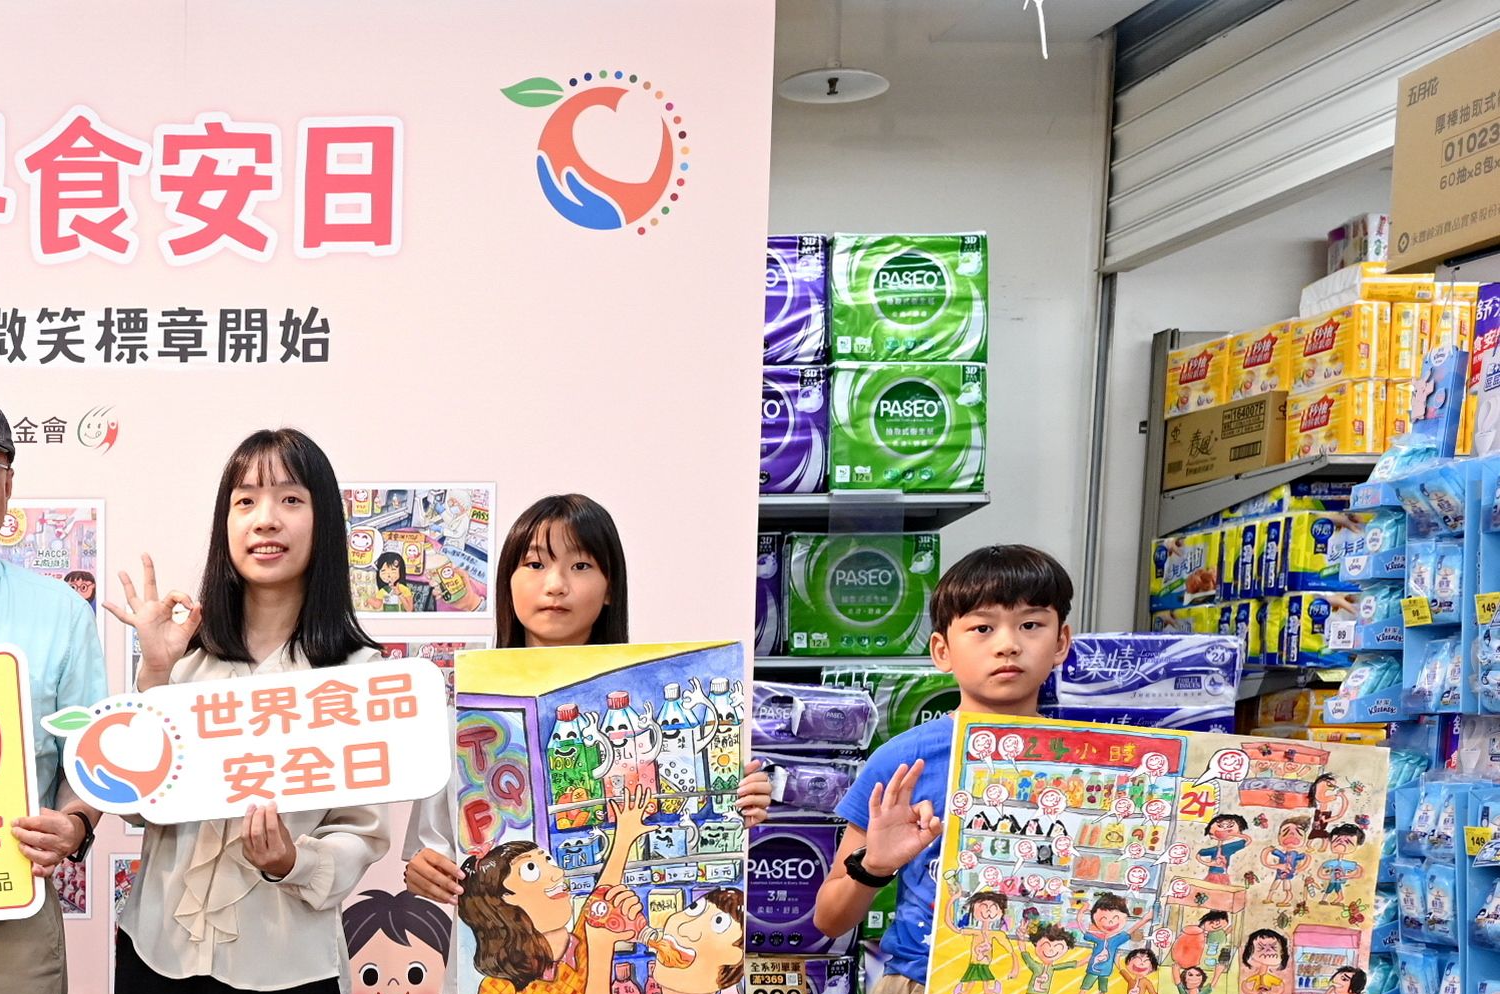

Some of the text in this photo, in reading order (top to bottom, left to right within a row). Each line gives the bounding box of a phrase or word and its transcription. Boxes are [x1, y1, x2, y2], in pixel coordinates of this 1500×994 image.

[1407, 76, 1439, 107] 五月花
[879, 270, 938, 289] PASEO
[879, 399, 939, 419] PASEO
[13, 416, 68, 445] 金會
[835, 568, 893, 586] PASEO
[1337, 630, 1347, 640] 89
[1212, 651, 1226, 663] 24
[190, 673, 418, 740] 世界食品
[759, 706, 793, 721] PASE
[1368, 706, 1397, 715] Kleenex
[550, 756, 578, 771] 100%
[222, 741, 392, 805] 安全日
[1180, 790, 1217, 818] 24
[1471, 836, 1486, 847] 149
[563, 852, 589, 868] FIN
